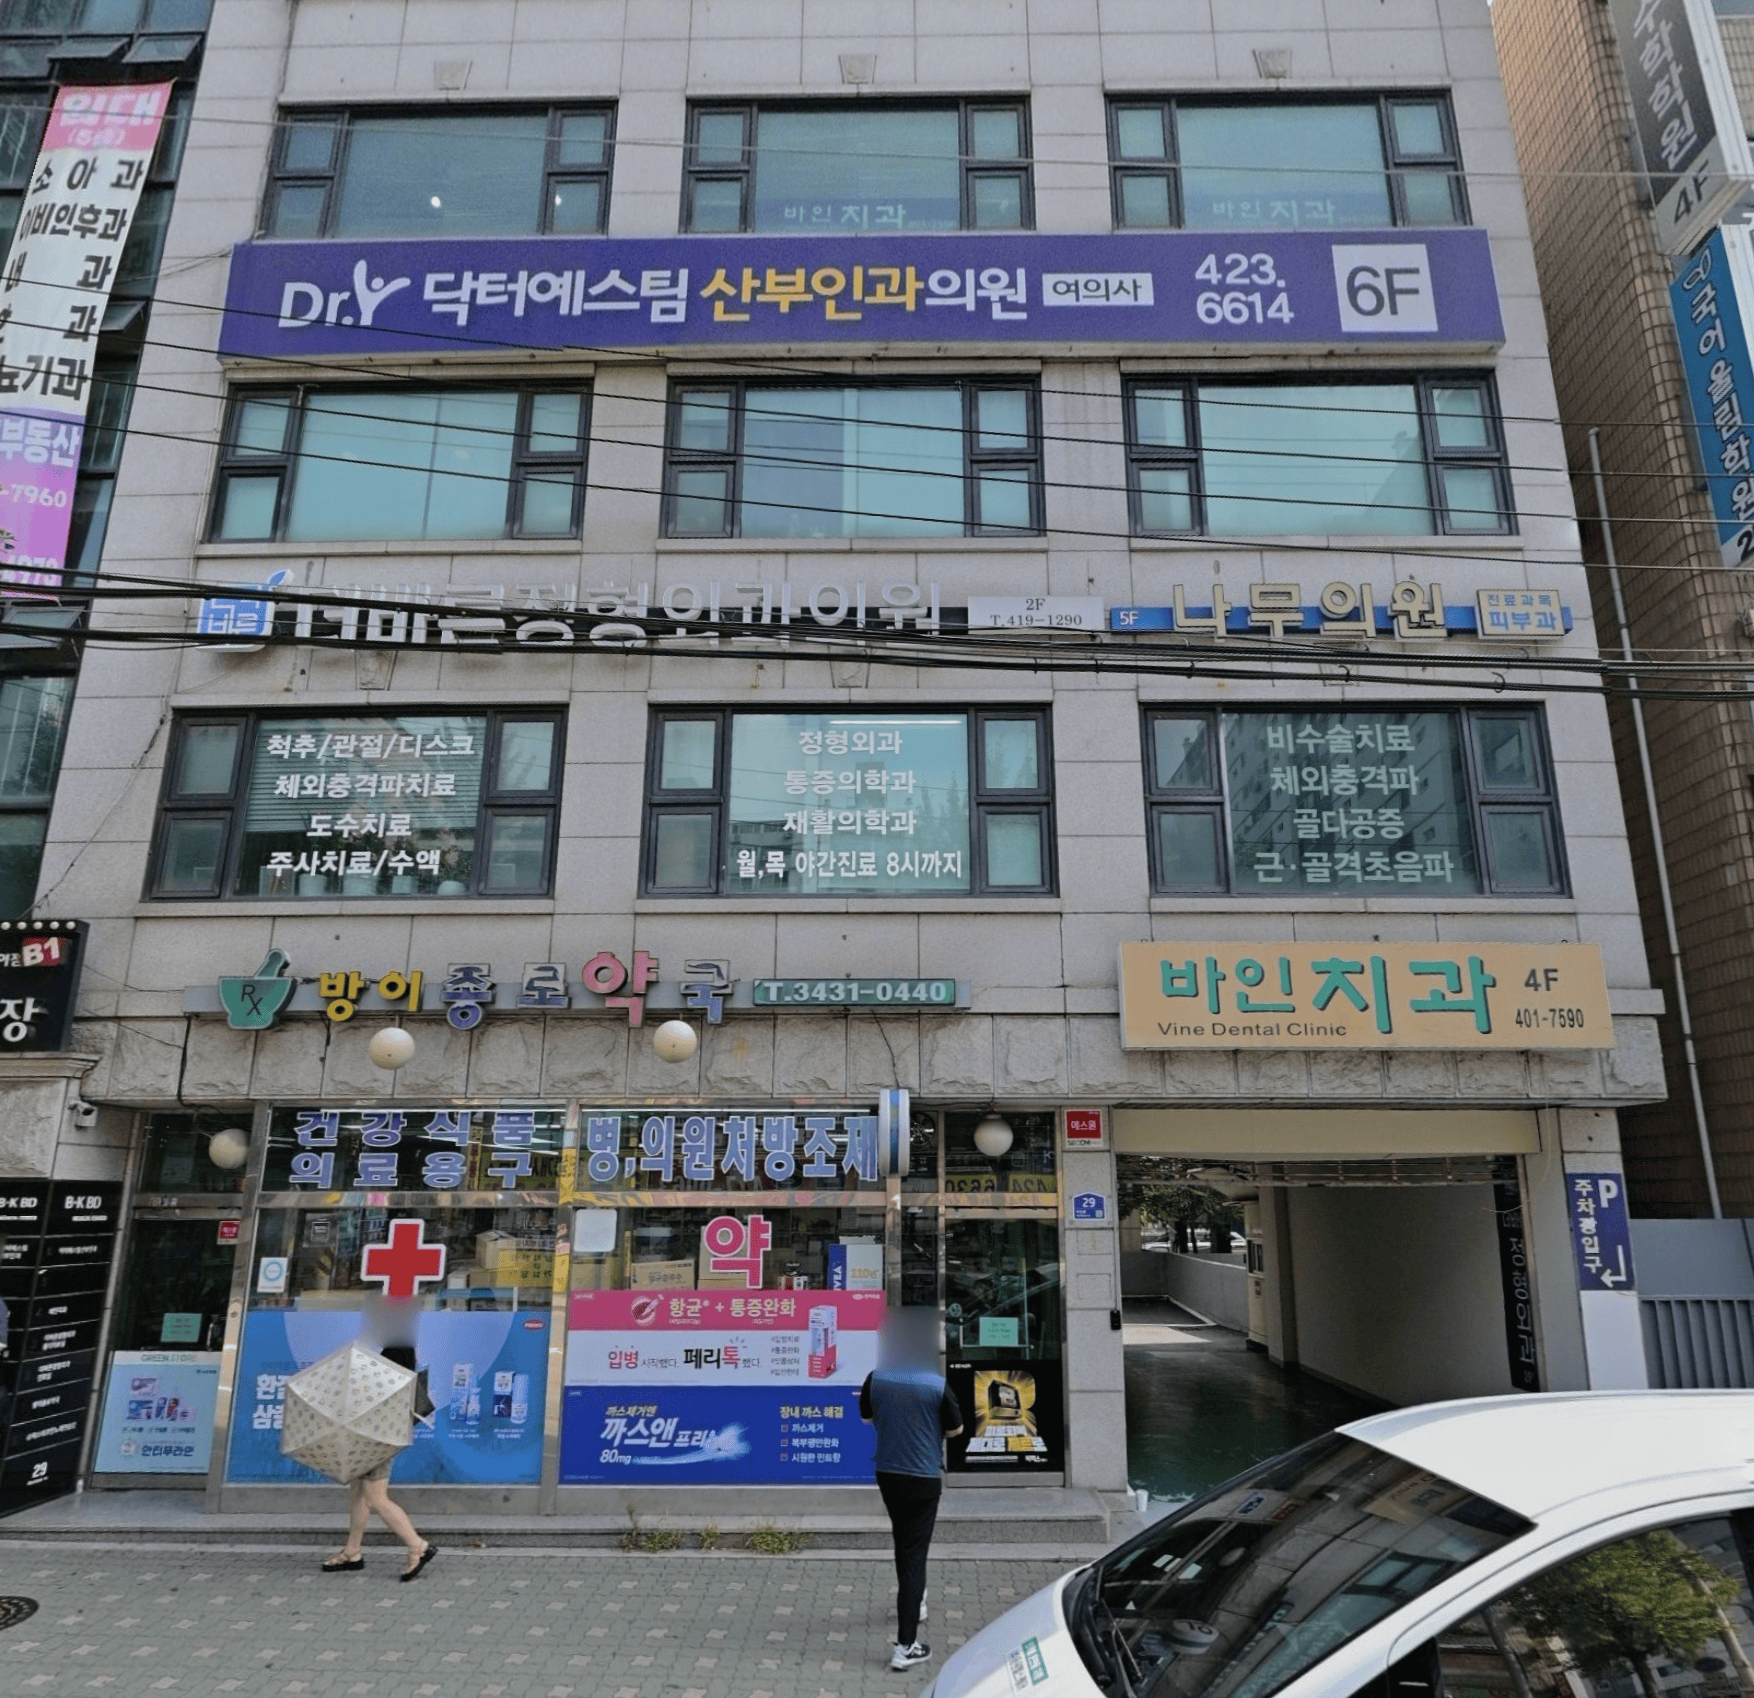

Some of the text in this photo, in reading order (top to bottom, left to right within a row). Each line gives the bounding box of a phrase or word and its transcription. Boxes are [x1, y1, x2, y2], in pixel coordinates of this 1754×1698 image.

[60, 90, 162, 128] 임대
[1674, 159, 1709, 224] 4F
[19, 202, 127, 243] 이비인후과
[423, 268, 690, 327] 닥터예스팀
[700, 265, 1028, 322] 산부인과의원
[1051, 278, 1143, 303] 여의사
[1346, 265, 1421, 317] 6F
[1196, 291, 1295, 325] 6614
[1025, 598, 1046, 611] 2F
[1119, 610, 1140, 626] 5F
[1173, 582, 1448, 642] 나무의원
[990, 614, 1083, 627] T.419-1290
[1489, 610, 1556, 632] 피부과
[266, 733, 475, 761] 척추/관절/디스크
[798, 731, 903, 755] 정형외과
[1266, 723, 1415, 754] 비수술치료
[274, 773, 456, 799] 체외충격파치료
[783, 769, 917, 794] 통증의학과
[1270, 764, 1419, 796] 체외충격파
[306, 813, 412, 838] 도수치료
[782, 809, 917, 835] 재활의학과
[1293, 808, 1405, 840] 골다공증
[266, 849, 441, 877] 주사치료/수액
[736, 849, 962, 880] 월,목 야간진료 8시까지
[23, 936, 61, 967] B1
[764, 981, 947, 1002] T.3431-0440
[1524, 968, 1558, 992] 4F
[1159, 955, 1496, 1034] 바인치과
[1156, 1020, 1347, 1036] Vine Dental Clinic
[1515, 1007, 1585, 1029] 401-7590
[1071, 1120, 1097, 1131] 에스원
[288, 1152, 533, 1188] 의료용구
[1082, 1198, 1096, 1209] 29
[1597, 1179, 1619, 1208] P
[1574, 1179, 1603, 1274] 주차장입구
[704, 1214, 771, 1289] 약
[728, 1297, 797, 1318] 통증완화
[607, 1347, 639, 1369] 입병
[801, 1406, 822, 1419] 까스
[823, 1406, 844, 1420] 해결
[600, 1417, 679, 1448] 까스앤
[600, 1448, 632, 1466] 80mg
